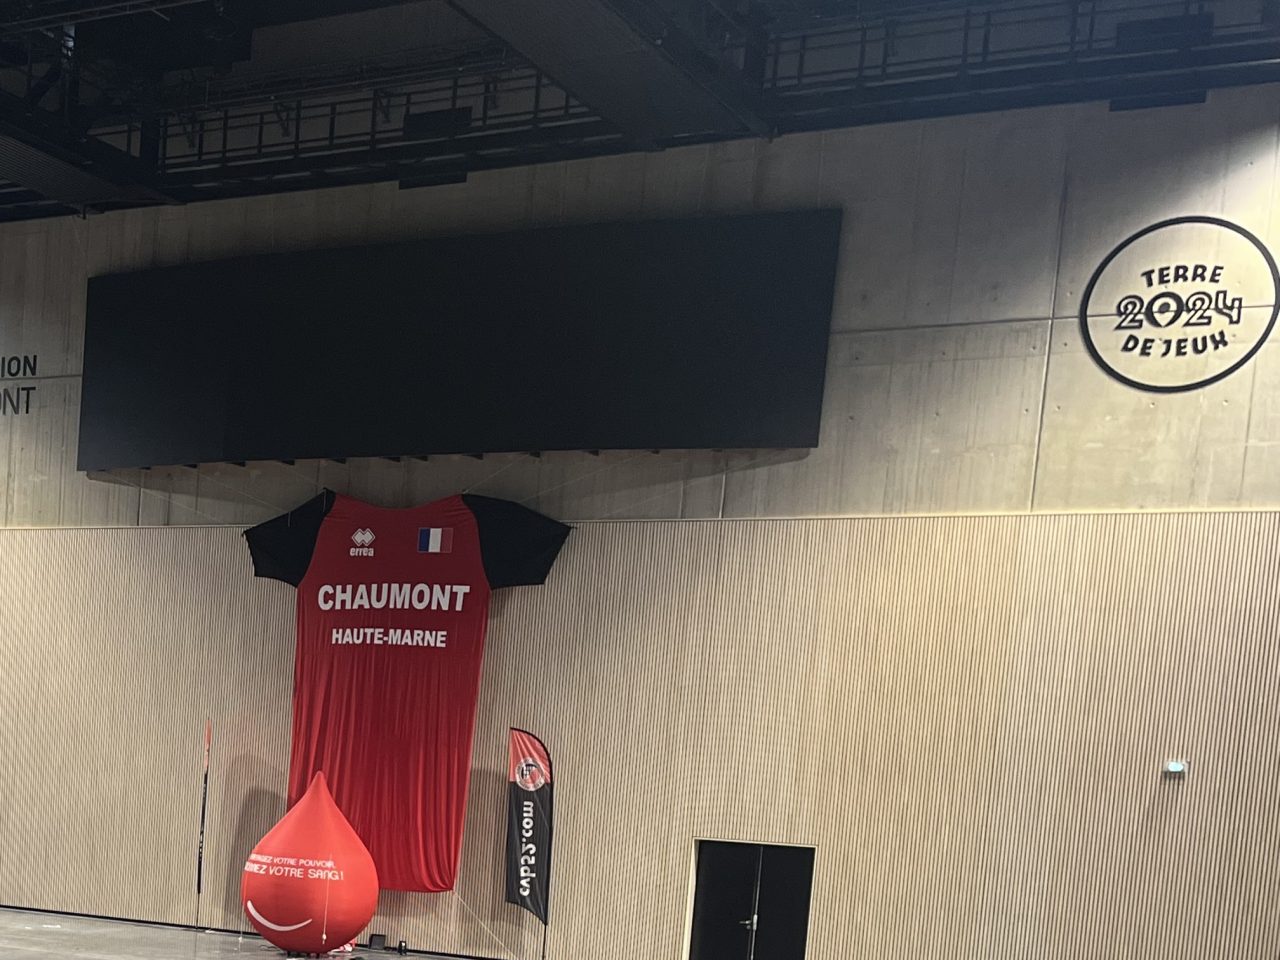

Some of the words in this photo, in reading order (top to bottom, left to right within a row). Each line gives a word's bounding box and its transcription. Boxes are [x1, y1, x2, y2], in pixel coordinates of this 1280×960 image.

[1141, 264, 1224, 288] TERRE
[1114, 290, 1243, 331] 2024
[1121, 334, 1155, 358] DE
[1160, 330, 1229, 358] JEUX
[318, 583, 470, 611] CHAUMONT
[331, 628, 447, 648] HAUTE-MARNE
[269, 866, 304, 878] VOTRE
